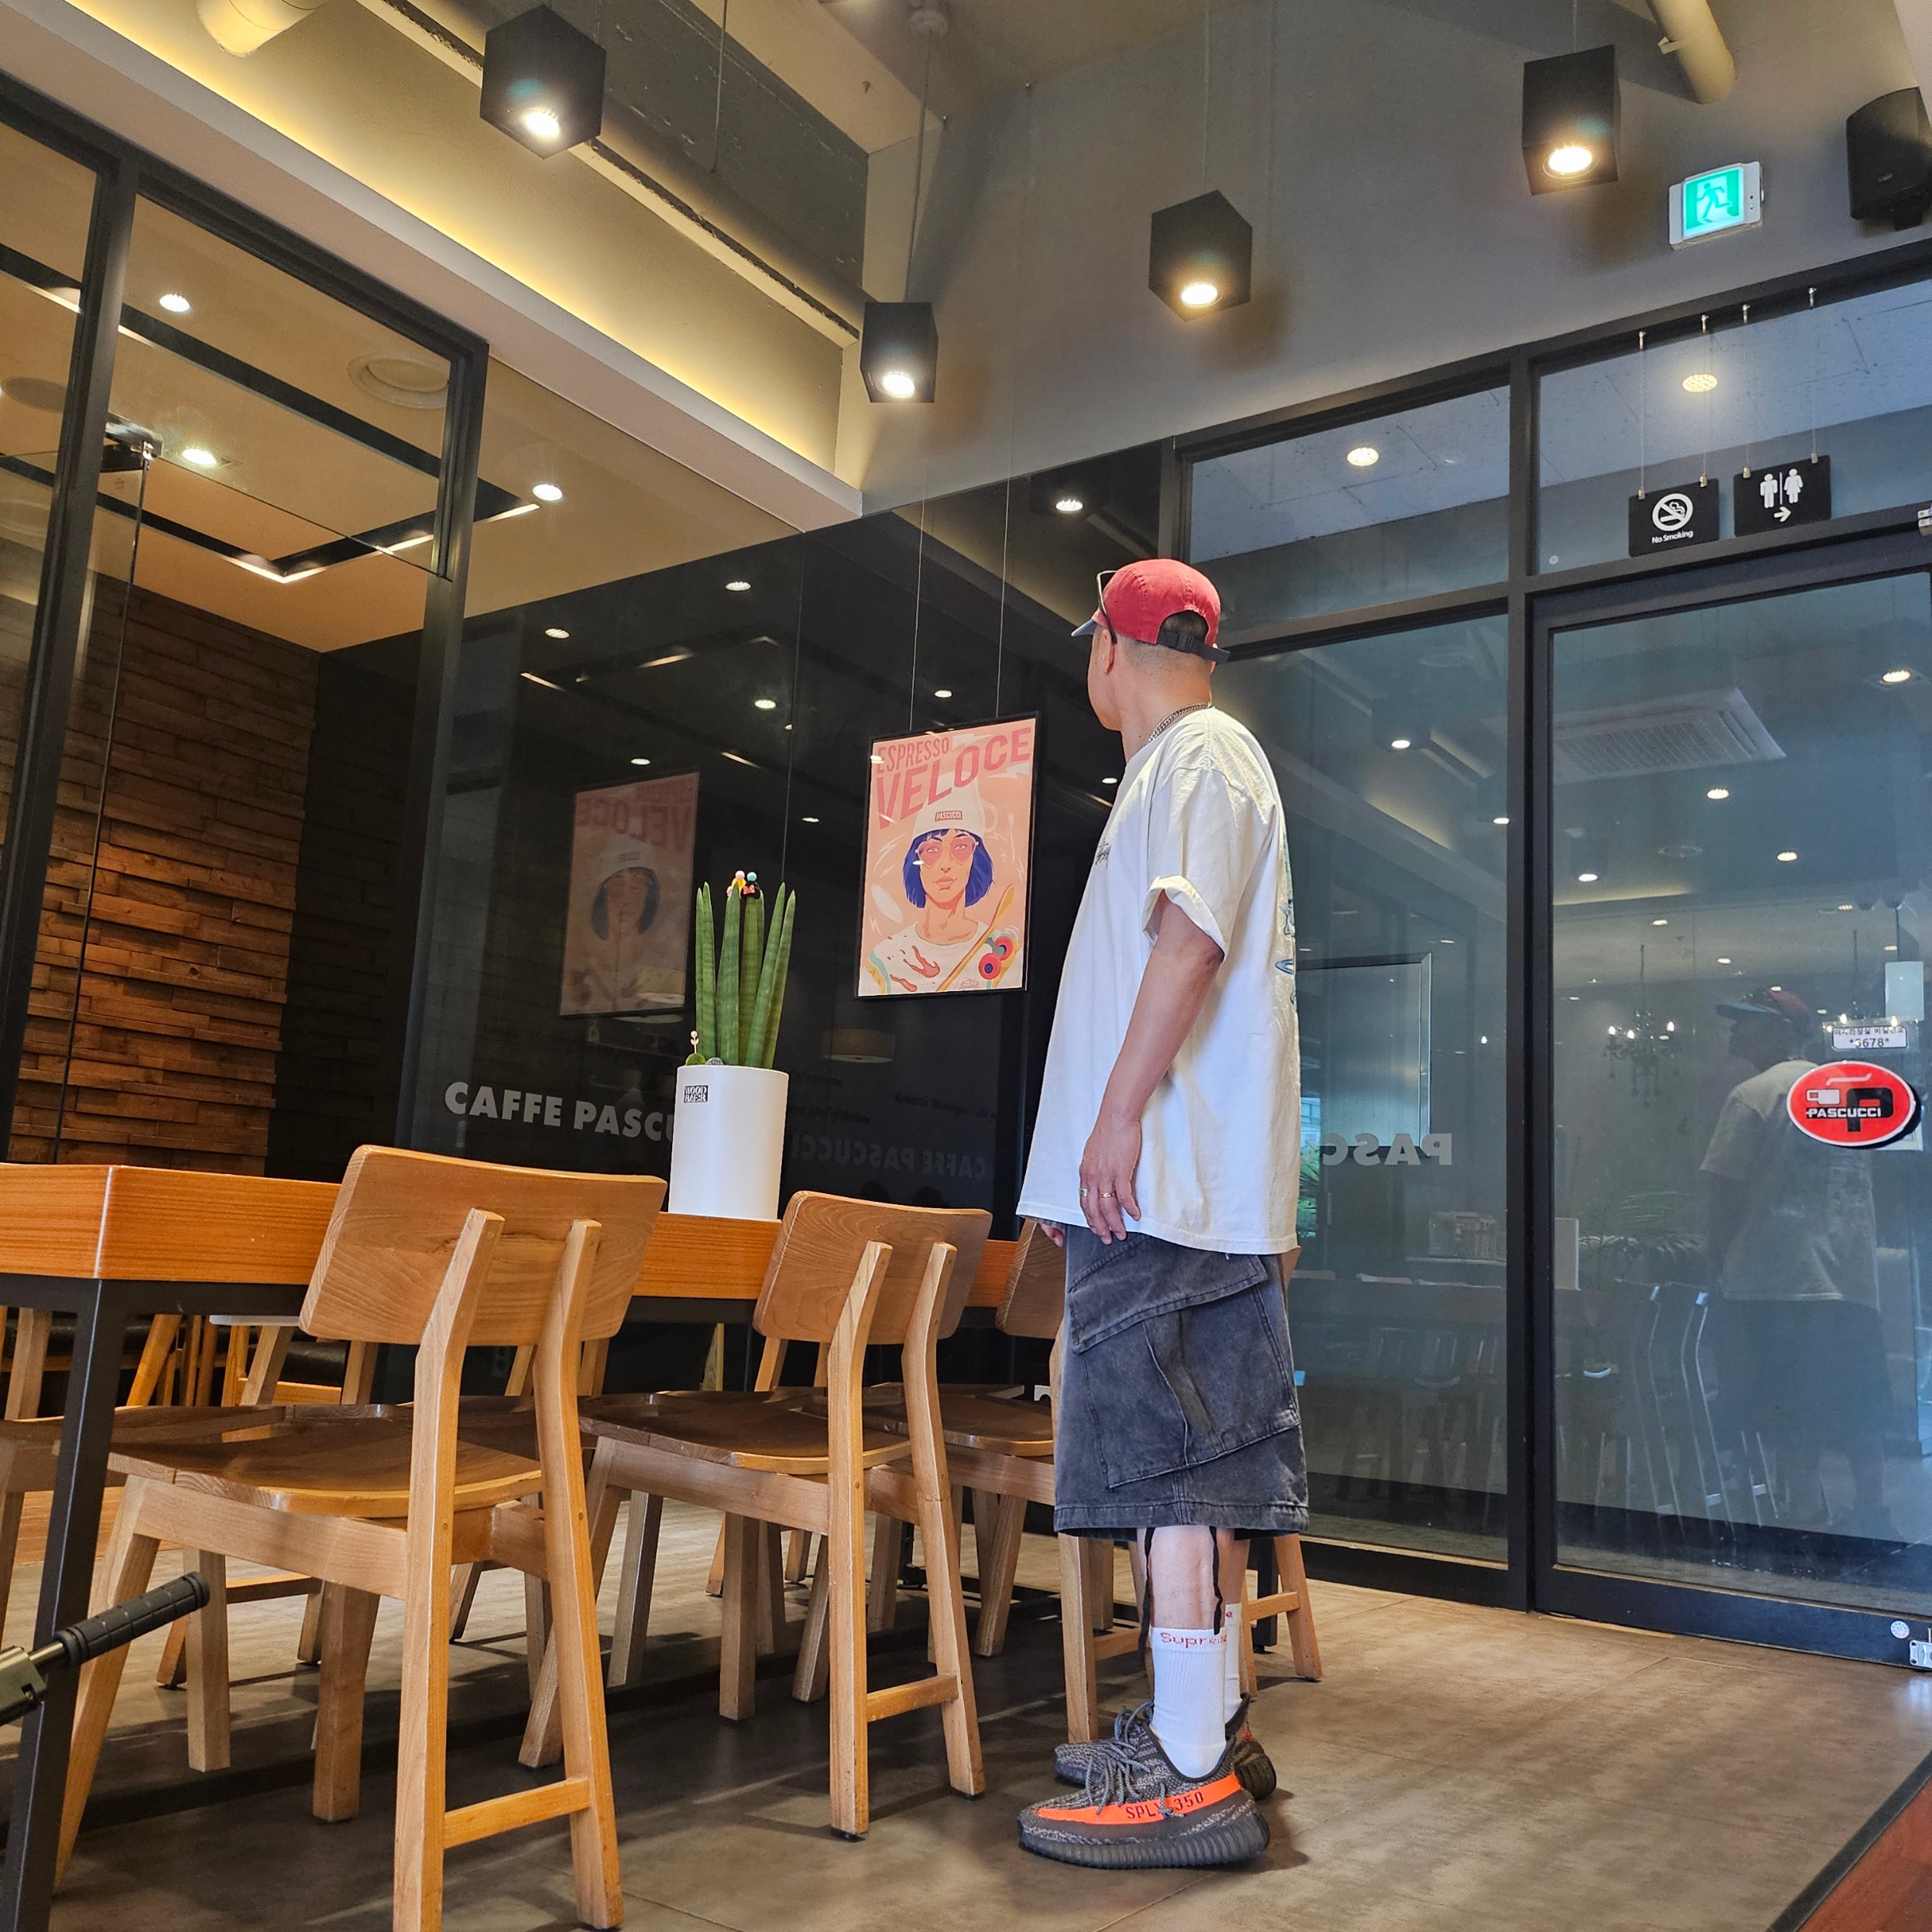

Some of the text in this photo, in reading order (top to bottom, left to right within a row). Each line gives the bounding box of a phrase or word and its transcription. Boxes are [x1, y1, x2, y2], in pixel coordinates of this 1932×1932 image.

[1663, 530, 1694, 541] Smoking
[877, 736, 950, 775] ESPRESSO
[877, 726, 1031, 830] VELOCE
[935, 811, 962, 821] PASCUCCI
[444, 1082, 562, 1127] CAFFE
[1806, 1107, 1882, 1117] PASCUCCI
[1174, 1791, 1204, 1811] 350
